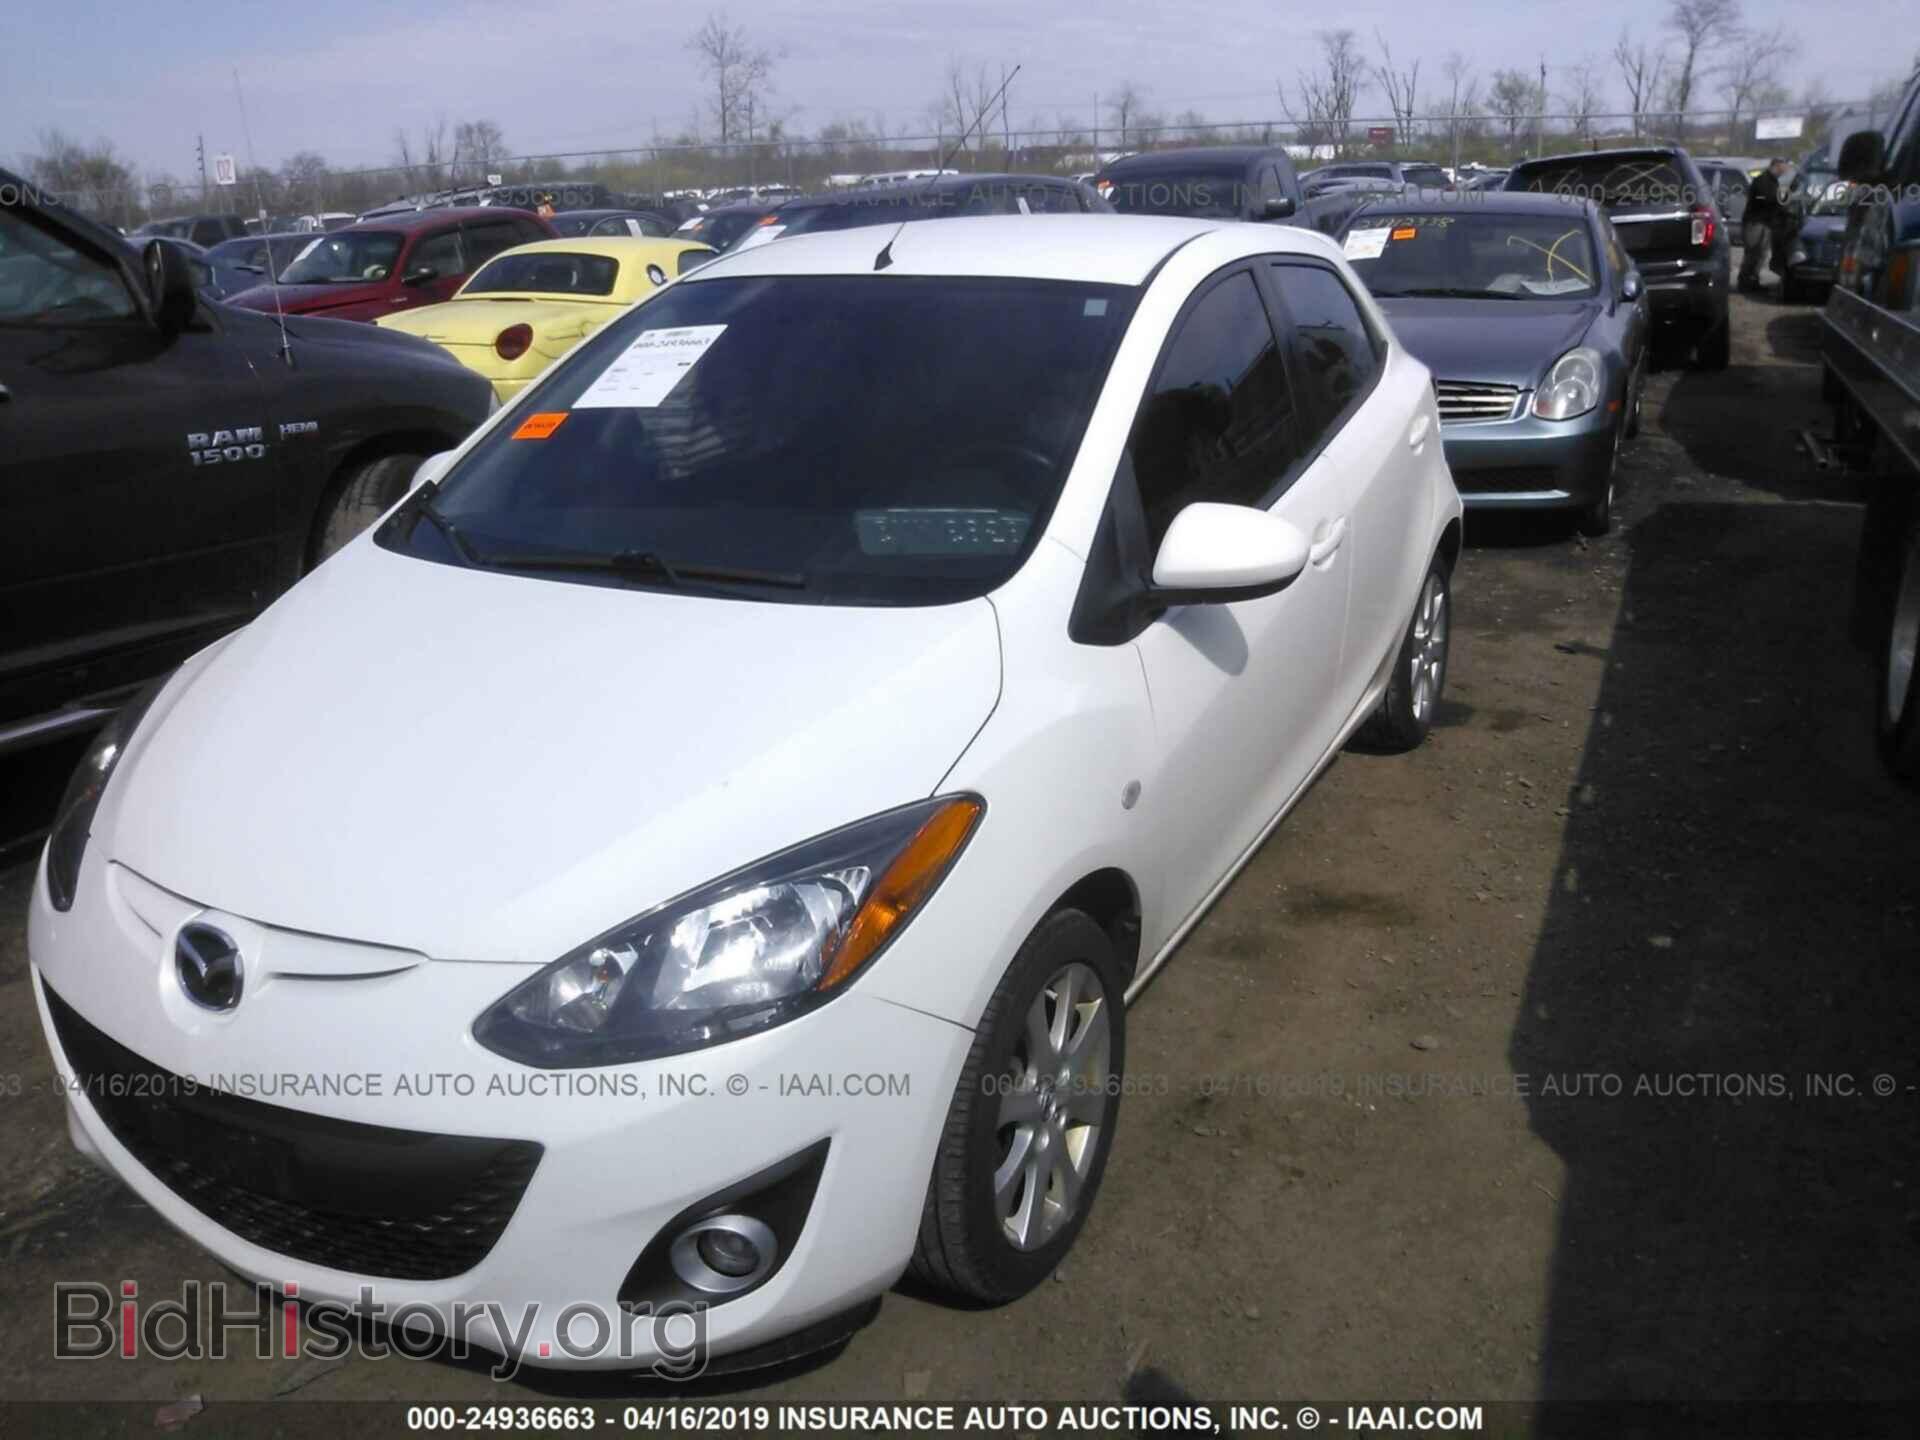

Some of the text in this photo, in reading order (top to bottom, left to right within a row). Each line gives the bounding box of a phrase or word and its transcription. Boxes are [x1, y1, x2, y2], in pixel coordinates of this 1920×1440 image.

[187, 421, 318, 448] RAM HEMI
[190, 444, 266, 467] 1500
